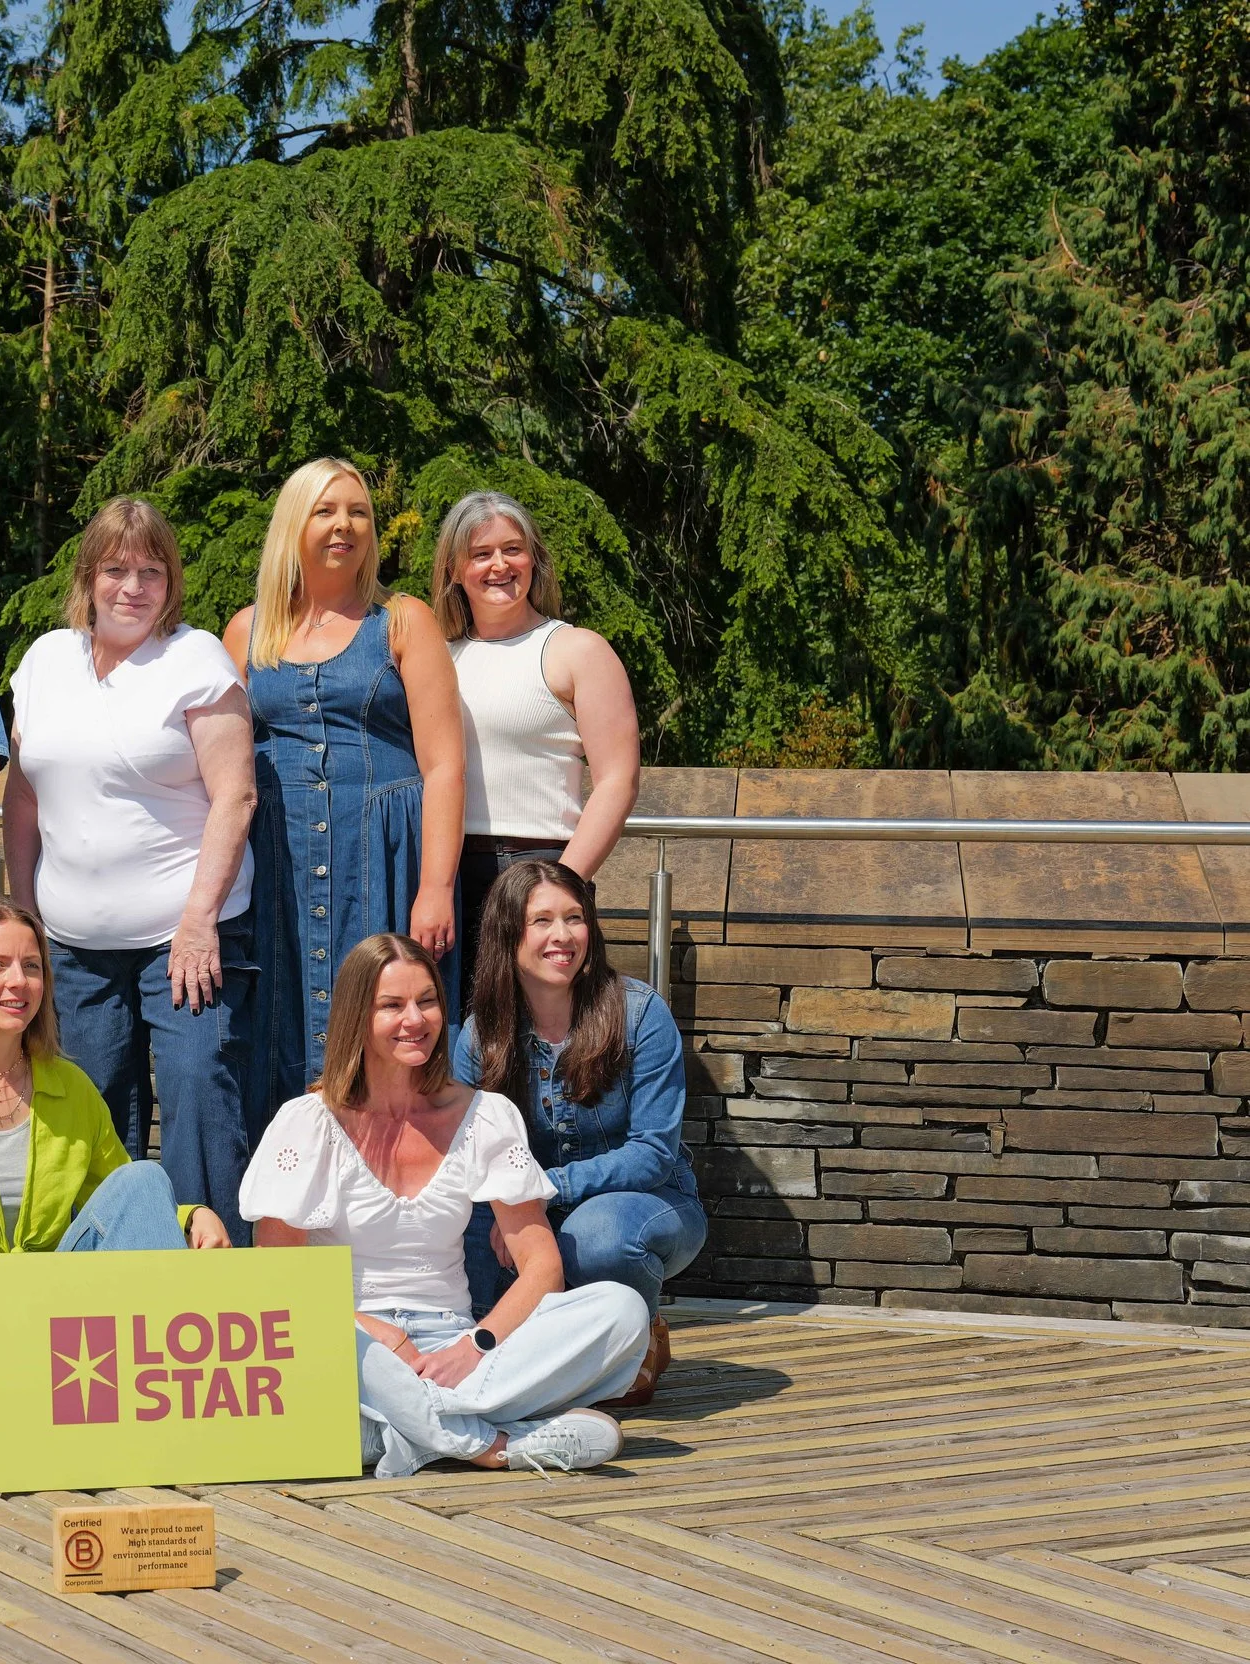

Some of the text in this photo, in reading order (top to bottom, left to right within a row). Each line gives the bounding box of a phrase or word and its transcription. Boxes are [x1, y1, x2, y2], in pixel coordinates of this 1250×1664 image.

[132, 1309, 295, 1364] LODE
[134, 1366, 285, 1422] STAR
[63, 1519, 102, 1527] Certified
[121, 1527, 134, 1535] We
[151, 1526, 173, 1535] proud
[128, 1539, 146, 1547] high
[76, 1539, 93, 1562] B
[113, 1550, 171, 1559] environmental
[172, 1549, 187, 1557] and
[138, 1562, 188, 1572] performance
